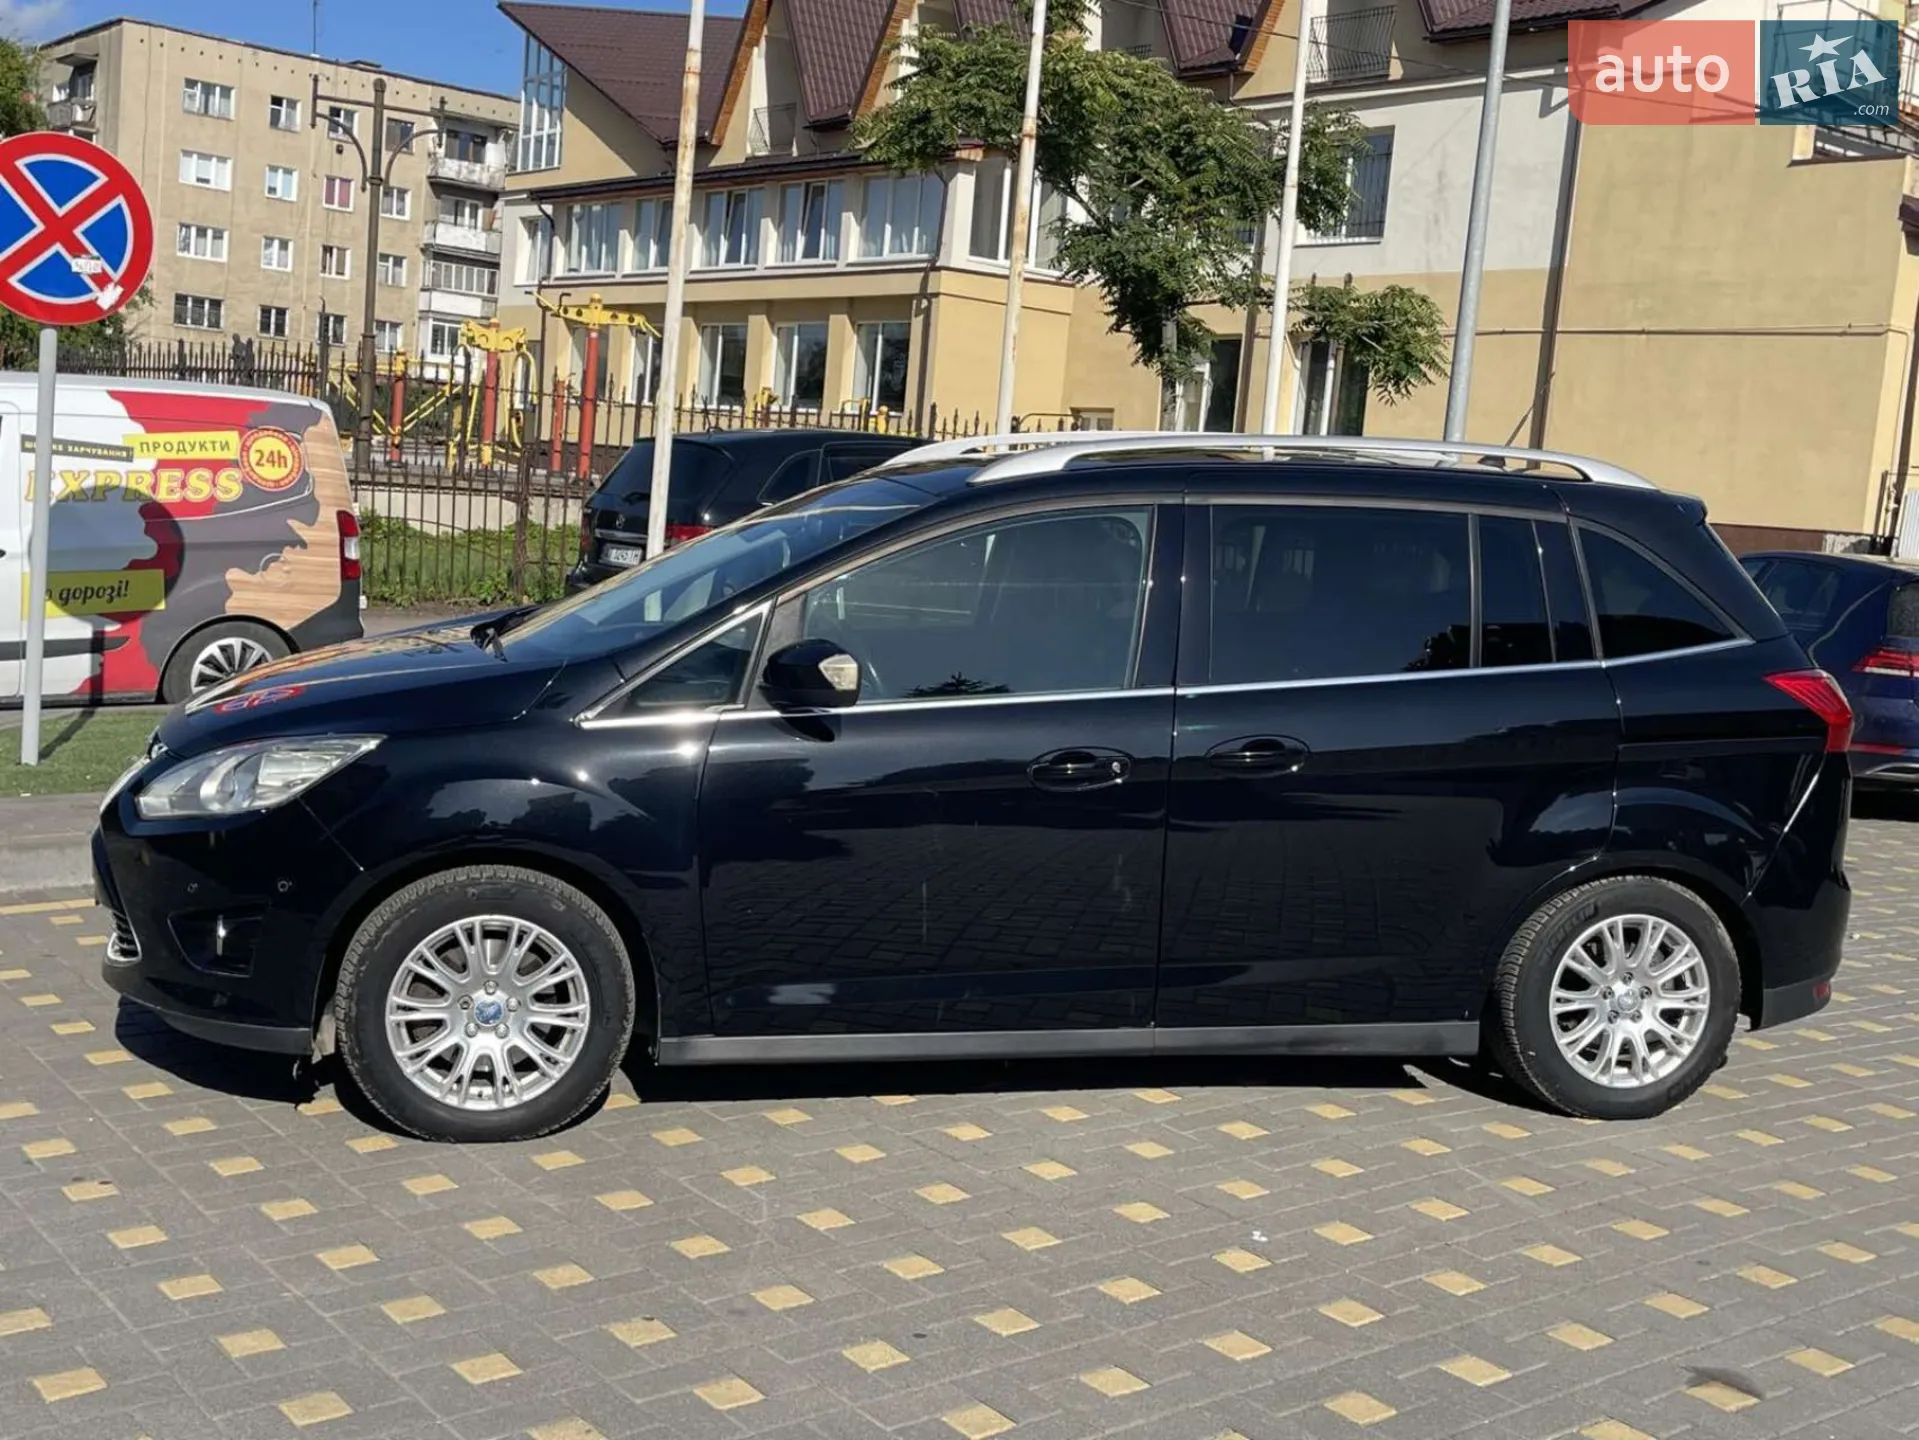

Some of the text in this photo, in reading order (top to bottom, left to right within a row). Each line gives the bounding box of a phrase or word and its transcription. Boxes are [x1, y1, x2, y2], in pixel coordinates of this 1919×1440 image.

[139, 440, 231, 454] ПРОДУКТИ
[254, 449, 288, 469] 24h
[58, 579, 130, 607] дорозі!
